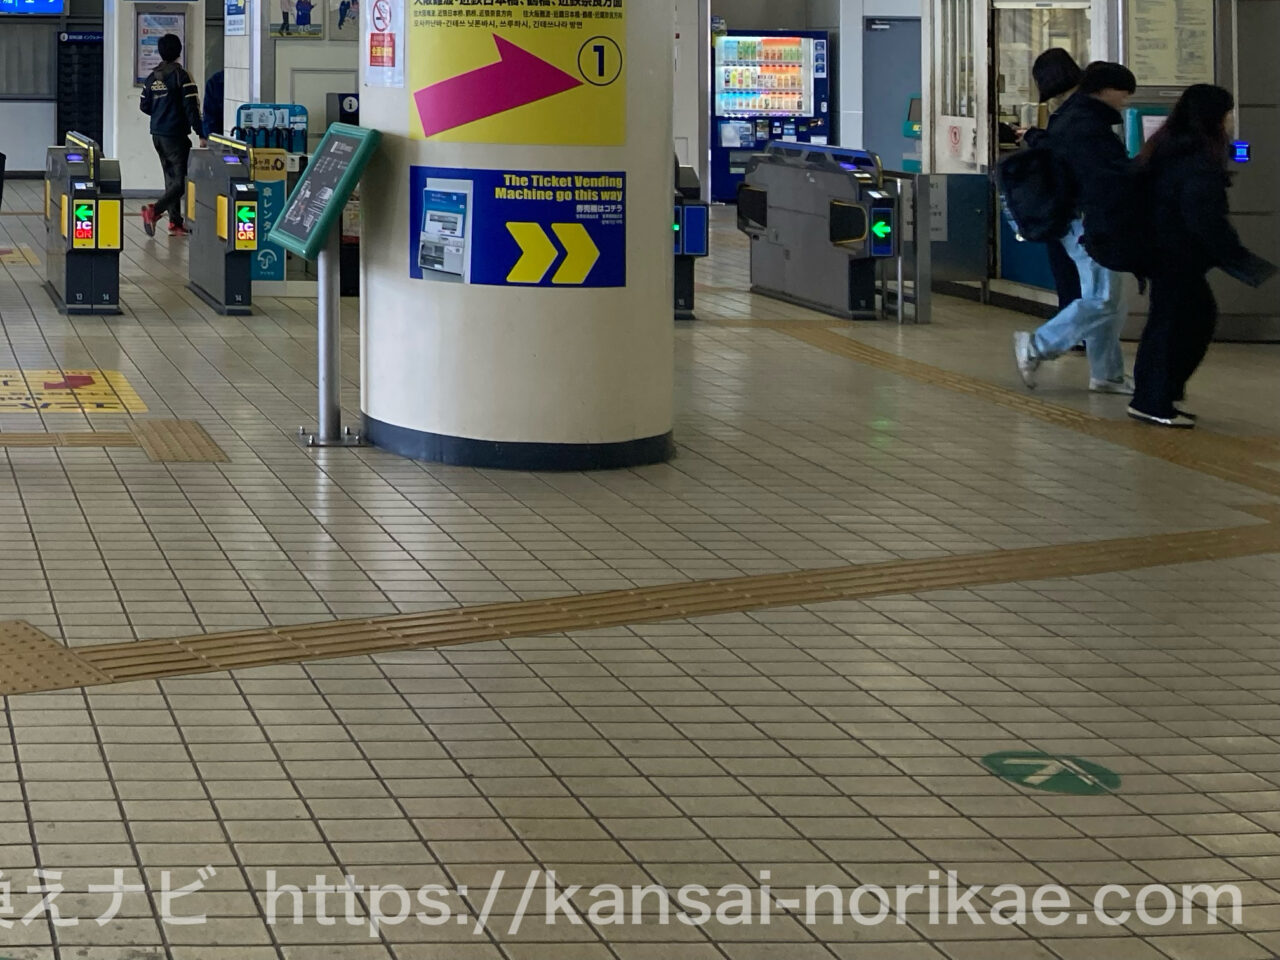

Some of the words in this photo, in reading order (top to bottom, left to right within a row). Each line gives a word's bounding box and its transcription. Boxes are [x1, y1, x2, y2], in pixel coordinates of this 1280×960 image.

[592, 45, 605, 77] 1
[503, 174, 529, 187] The
[531, 175, 573, 187] Ticket
[574, 175, 623, 189] Vending
[495, 187, 553, 200] Machine
[556, 190, 572, 202] go
[574, 189, 599, 201] this
[600, 190, 623, 202] way
[76, 221, 92, 230] IC
[238, 222, 254, 231] IC
[76, 230, 92, 239] QR
[237, 231, 255, 240] QR
